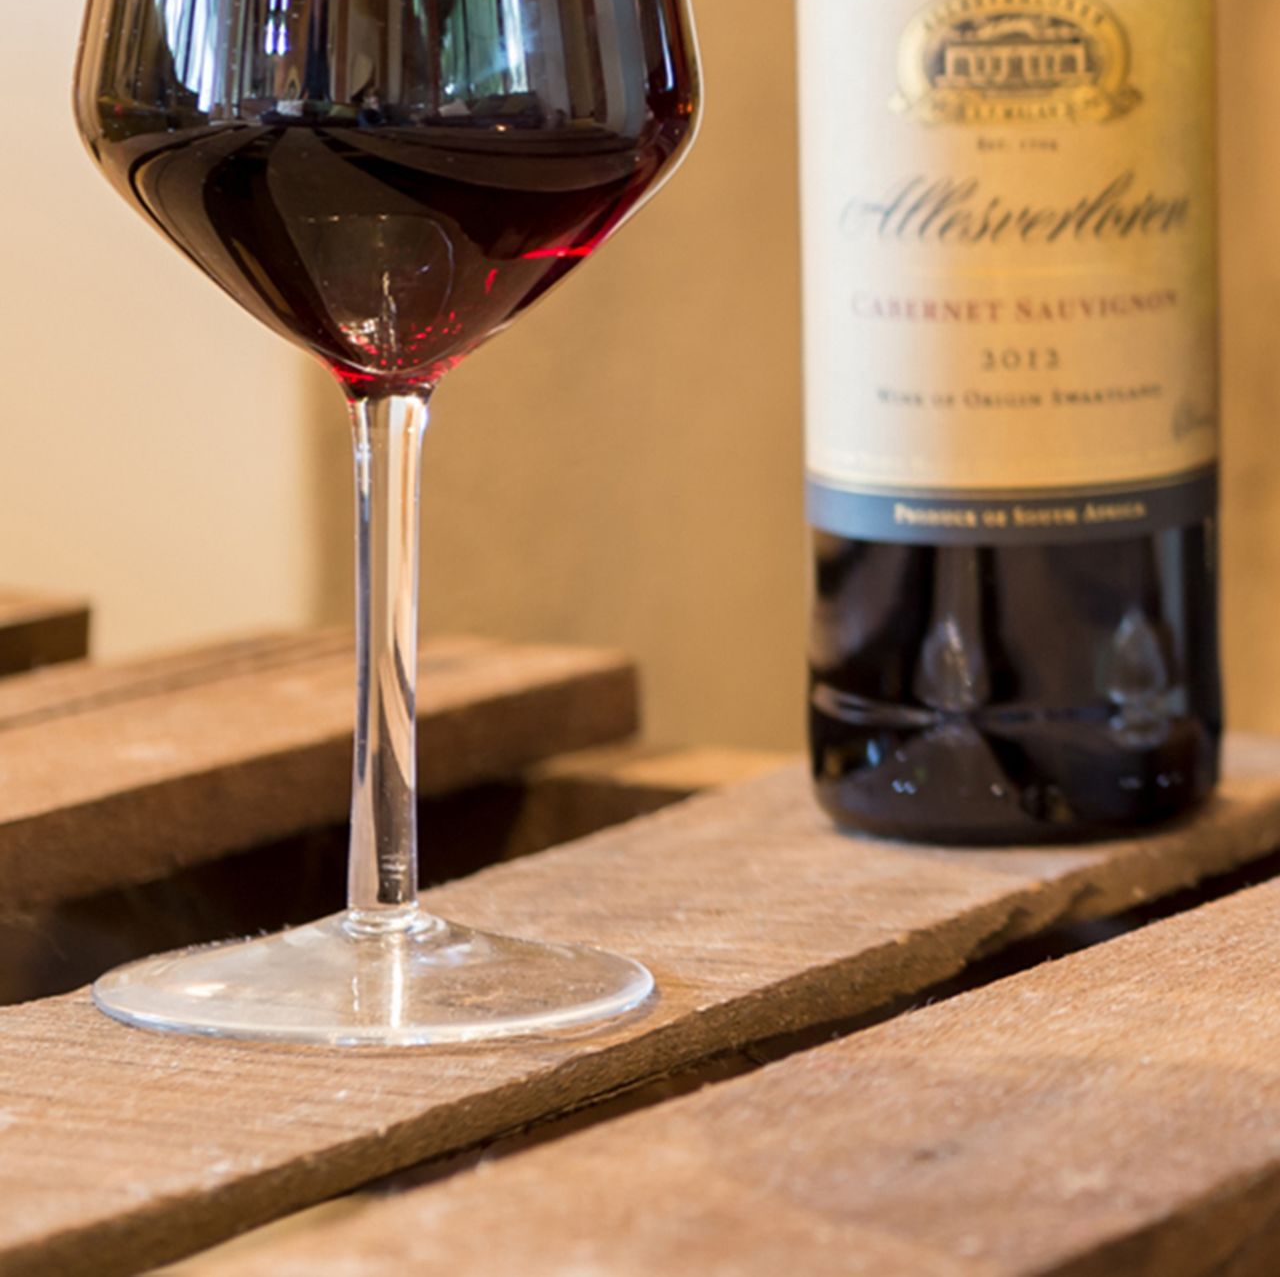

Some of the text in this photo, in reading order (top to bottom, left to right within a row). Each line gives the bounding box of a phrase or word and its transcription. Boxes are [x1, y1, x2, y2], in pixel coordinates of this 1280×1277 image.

[839, 168, 1189, 244] Allesverloren
[852, 288, 1178, 323] CABERNET SAUVIGNON
